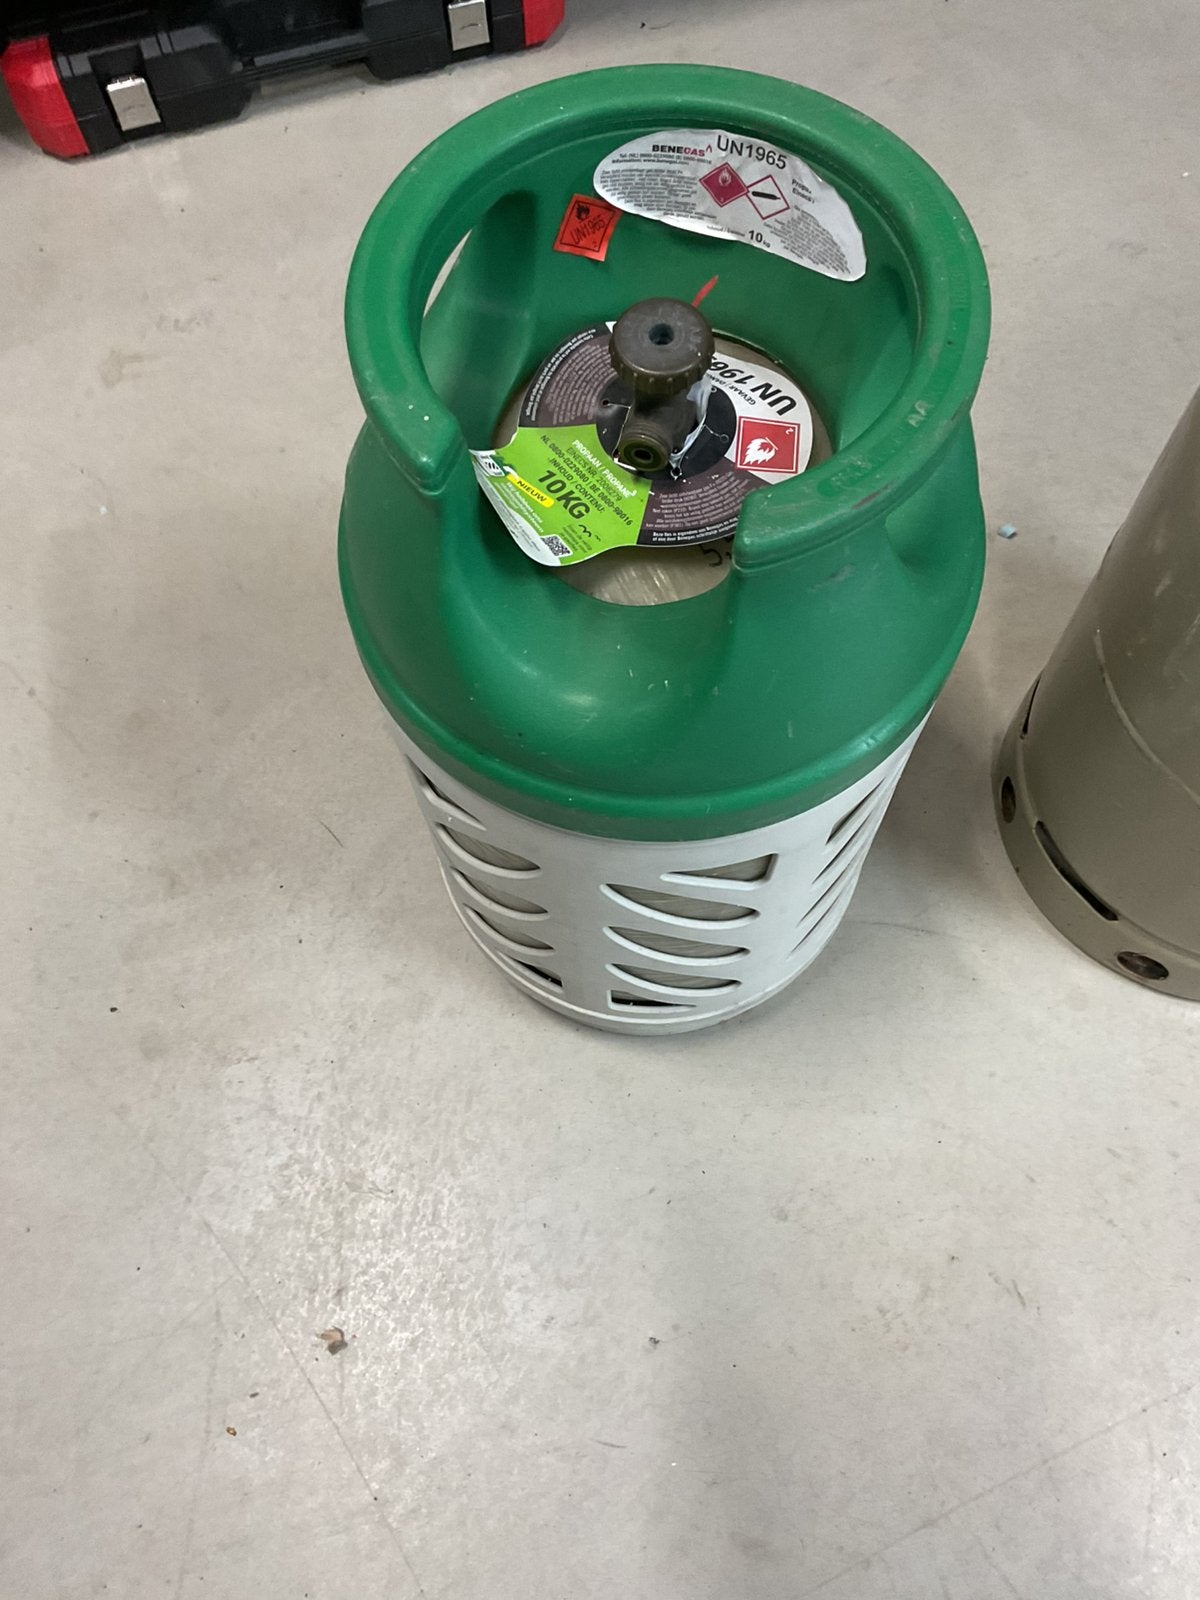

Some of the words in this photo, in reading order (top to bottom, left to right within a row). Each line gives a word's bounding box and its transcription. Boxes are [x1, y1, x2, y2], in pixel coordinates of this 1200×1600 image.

[652, 144, 705, 157] BENEGAS
[716, 134, 787, 170] UN1965
[748, 230, 763, 243] 10
[710, 356, 755, 385] 196
[730, 385, 755, 405] GEVAAR
[751, 381, 797, 416] UN
[573, 439, 601, 467] PROPAAN
[517, 480, 547, 502] NIEUW
